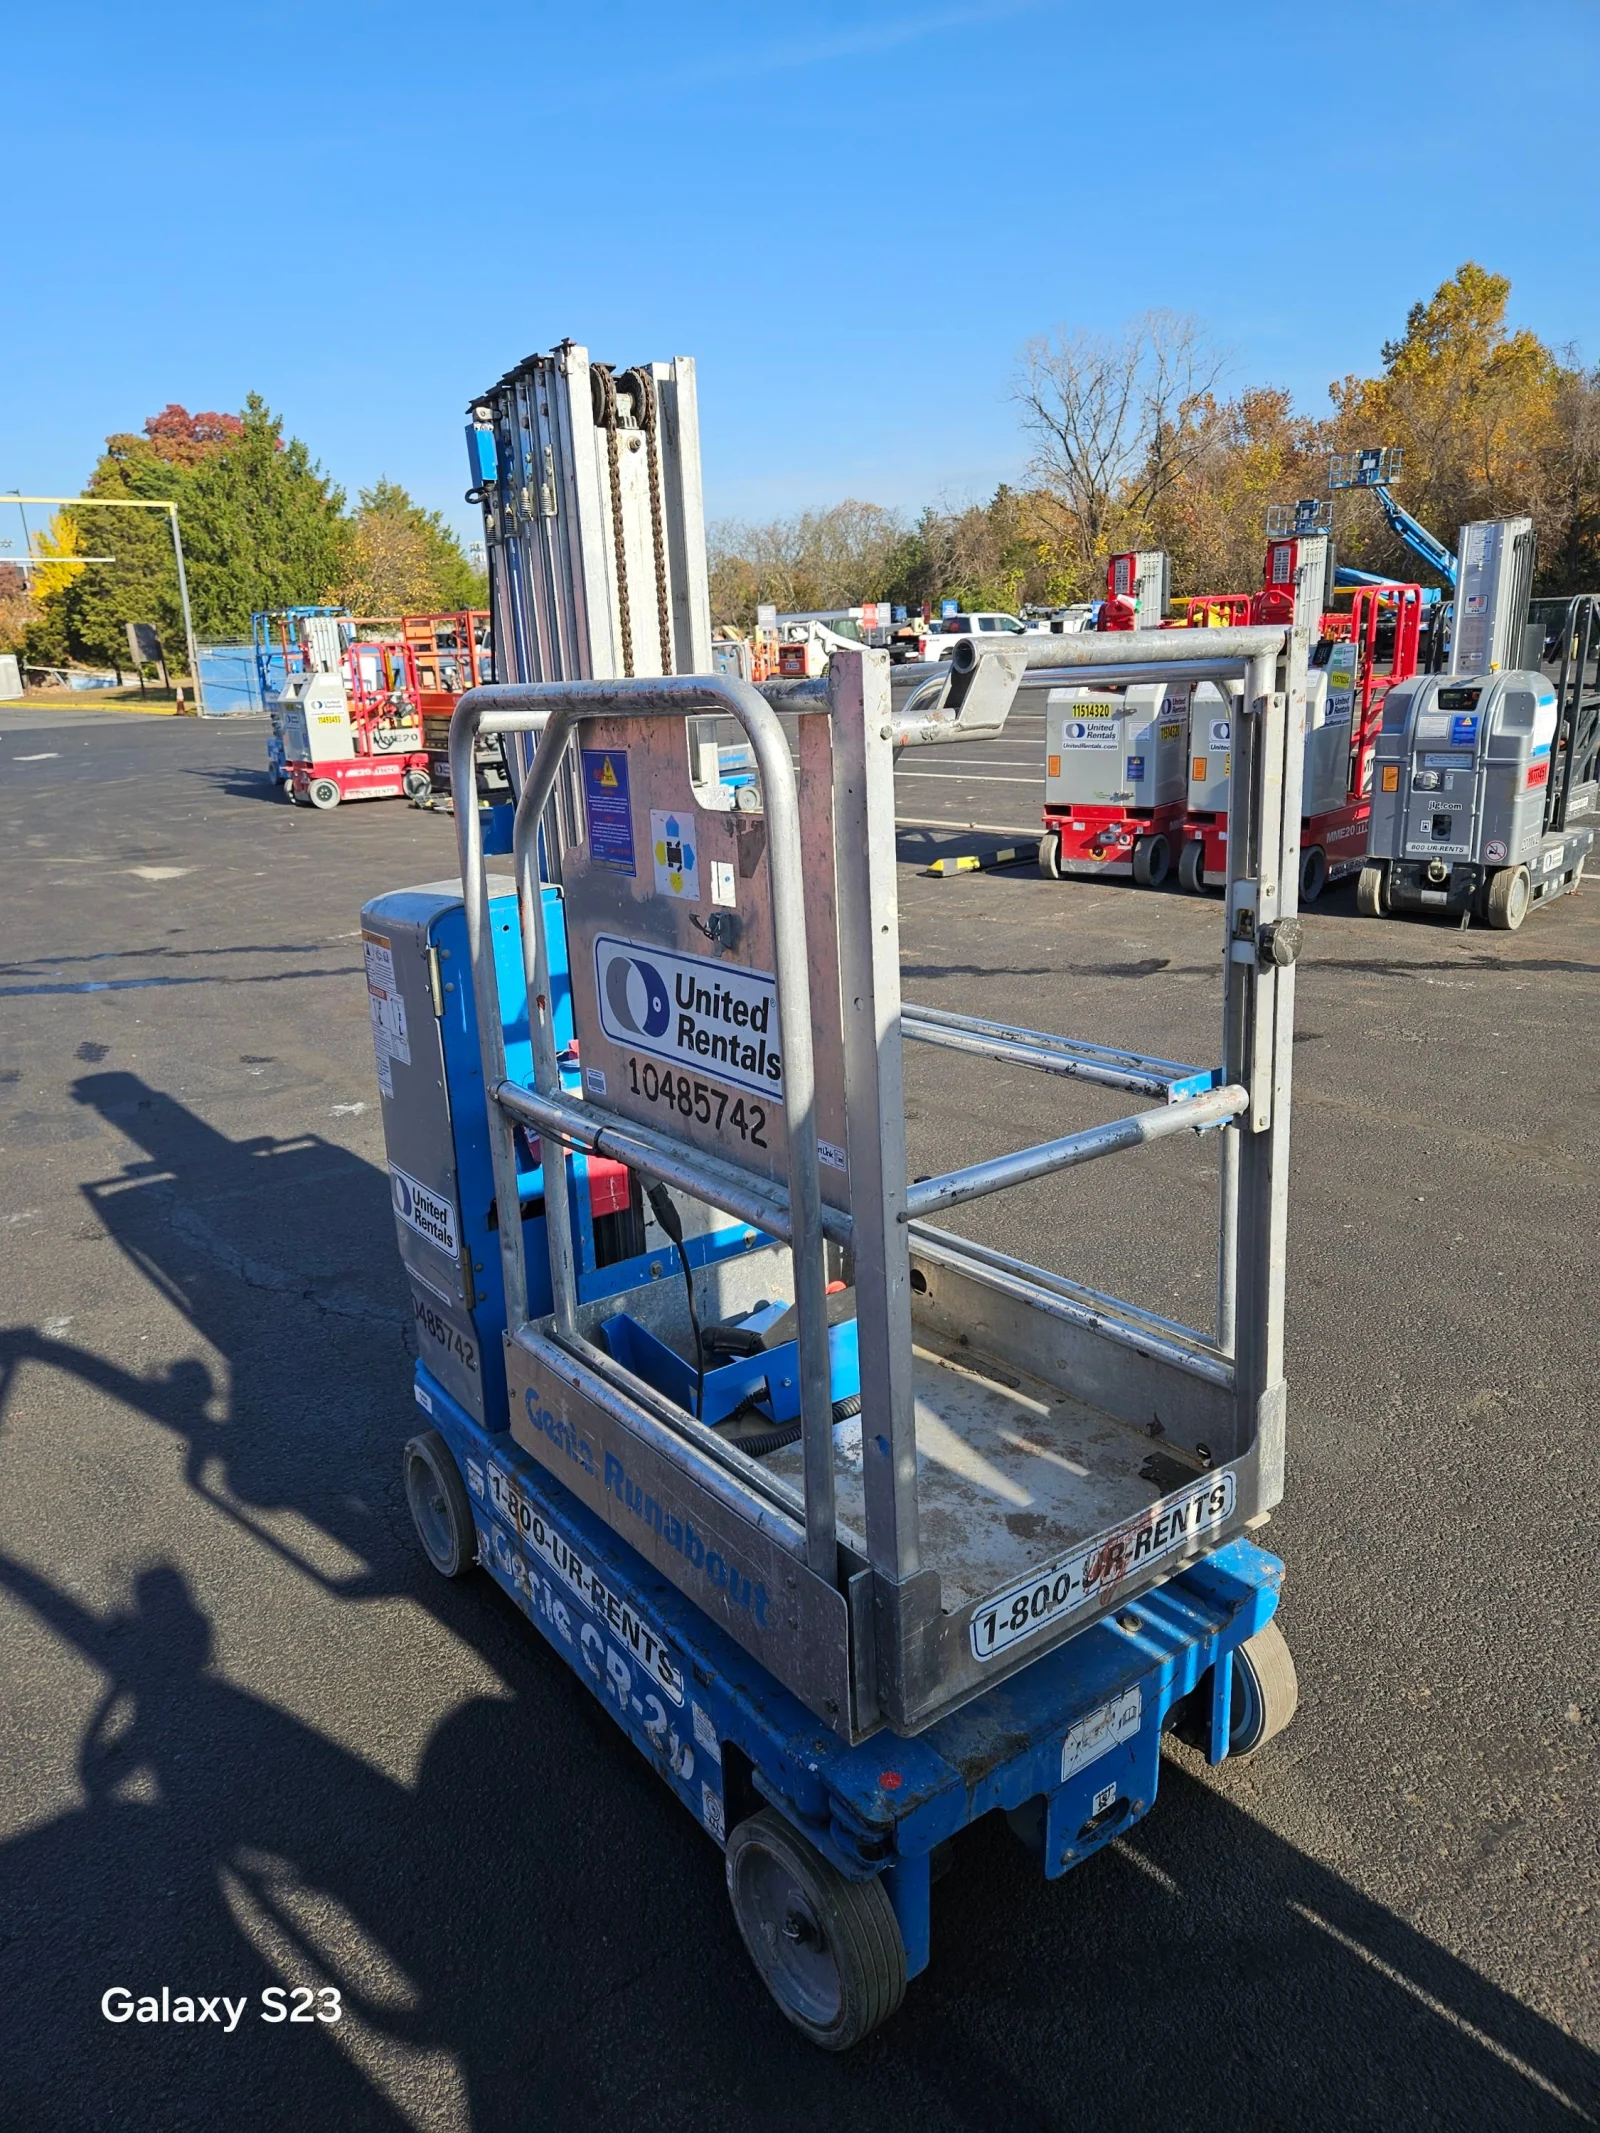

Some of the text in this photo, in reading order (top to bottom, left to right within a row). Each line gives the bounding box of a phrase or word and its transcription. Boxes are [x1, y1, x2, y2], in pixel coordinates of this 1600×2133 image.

[1072, 704, 1110, 718] 11514320
[1087, 723, 1114, 732] United
[1087, 731, 1116, 741] Rentals
[1428, 801, 1463, 812] jlg.com
[1326, 825, 1356, 844] MME20
[675, 972, 769, 1033] United
[677, 1015, 781, 1081] Rentals
[628, 1056, 768, 1149] 10485742
[412, 1187, 447, 1226] United
[414, 1207, 453, 1249] Rentals
[604, 1449, 771, 1629] Runabout
[492, 1475, 675, 1686] 1-800-UR-RENTS
[982, 1484, 1227, 1646] 1-800-UR-RENTS
